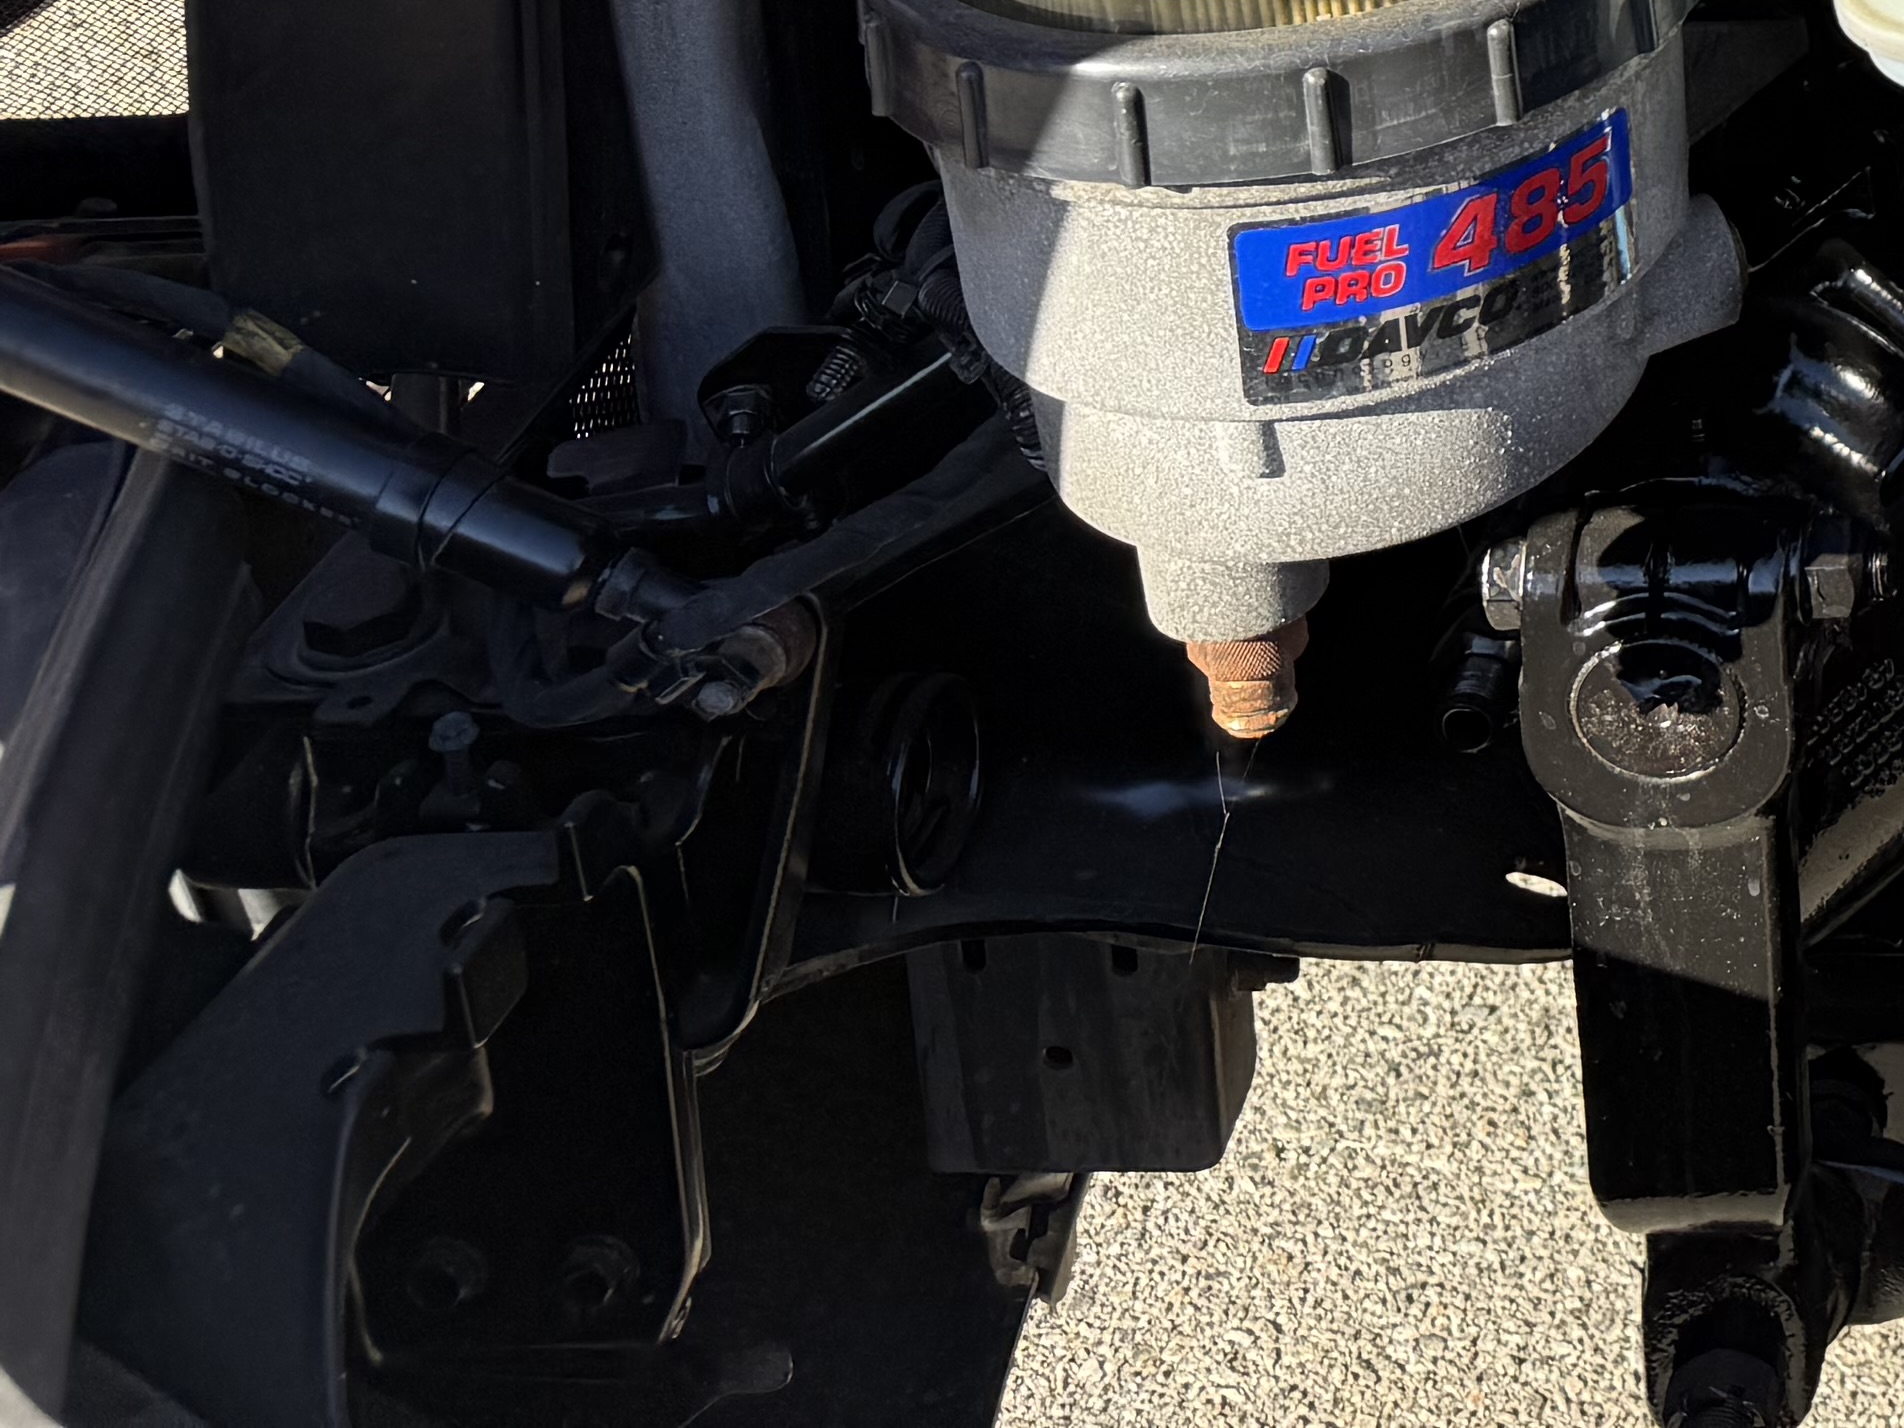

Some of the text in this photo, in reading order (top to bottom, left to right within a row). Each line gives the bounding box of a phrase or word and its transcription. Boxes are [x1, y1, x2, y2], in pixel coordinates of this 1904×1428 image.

[1430, 126, 1613, 277] 485
[1285, 224, 1410, 278] FUEL
[1302, 261, 1407, 312] PRO
[1315, 282, 1517, 366] DAVCO
[165, 403, 311, 471] STABILUS
